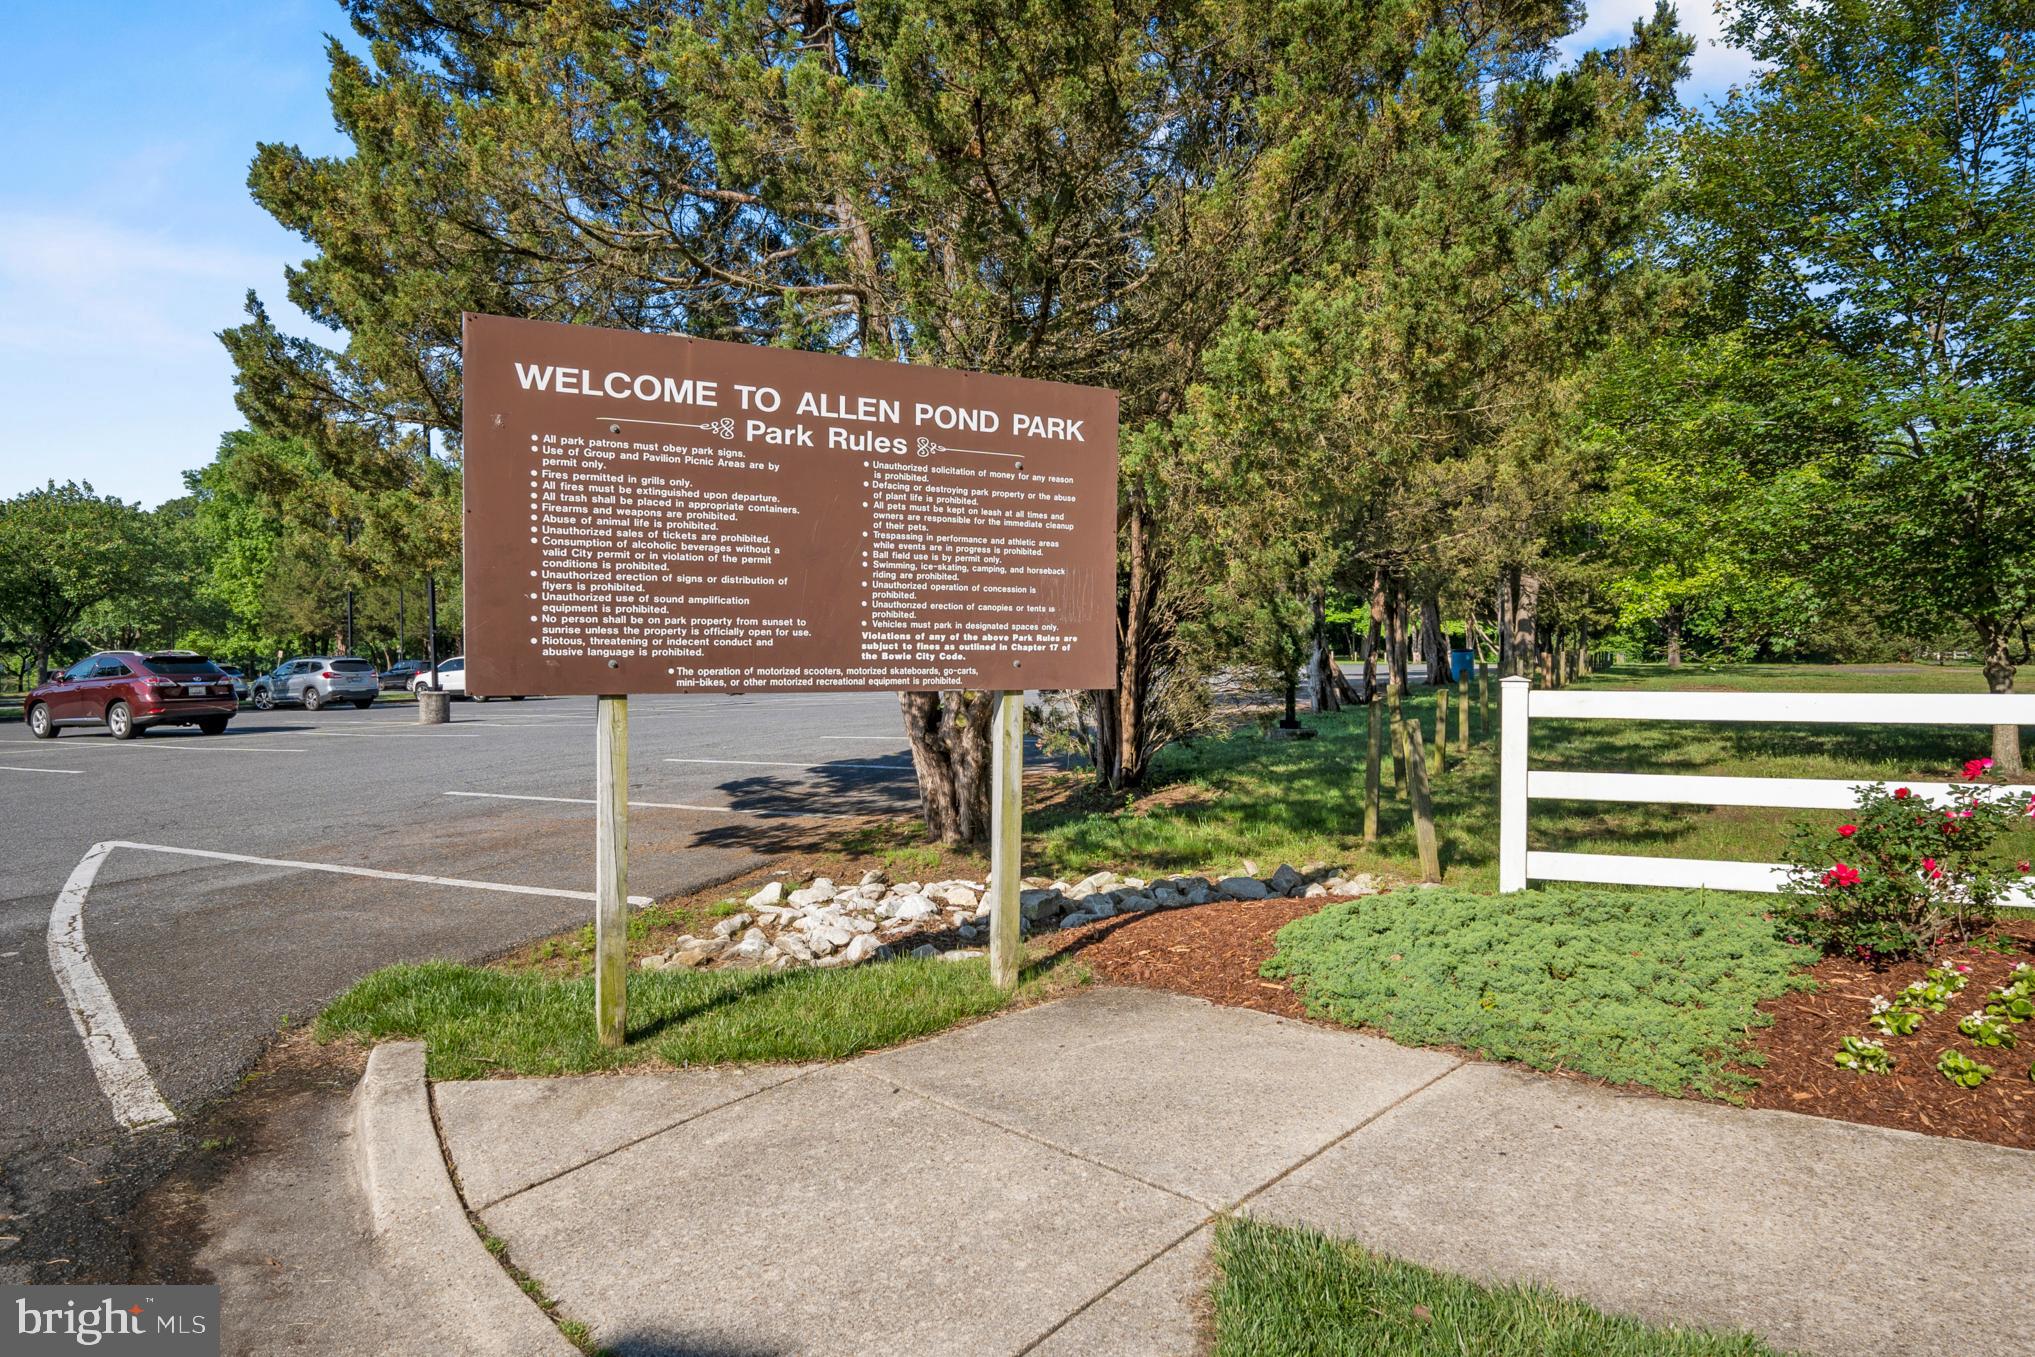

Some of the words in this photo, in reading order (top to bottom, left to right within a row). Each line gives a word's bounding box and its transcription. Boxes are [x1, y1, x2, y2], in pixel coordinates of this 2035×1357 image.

[514, 362, 717, 406] WELCOME
[733, 384, 781, 412] TO
[796, 391, 899, 423] ALLEN
[915, 402, 999, 432] POND
[1013, 413, 1084, 441] PARK
[746, 419, 814, 447] Park
[828, 426, 907, 454] Rules
[543, 434, 556, 443] All
[560, 436, 584, 445] park
[588, 439, 629, 449] patrons
[633, 442, 658, 451] must
[662, 443, 687, 454] obey
[691, 446, 713, 455] park
[717, 447, 745, 458] signs.
[542, 444, 563, 455] Use
[568, 447, 579, 456] of
[583, 447, 615, 460] Group
[619, 451, 639, 460] and
[642, 452, 680, 463] Pavilion
[684, 455, 713, 466] Picnic
[717, 458, 745, 468] Areas
[768, 461, 779, 472] by
[542, 458, 576, 466] permit
[581, 459, 606, 470] only.
[541, 469, 568, 479] Fires
[572, 473, 623, 482] permitted
[627, 474, 636, 483] in
[640, 476, 665, 486] grills
[669, 478, 692, 488] only.
[872, 460, 928, 472] Unauthorized
[931, 466, 975, 476] solicitation
[977, 469, 986, 477] of
[989, 471, 1015, 480] money
[1018, 472, 1029, 480] for
[1031, 474, 1045, 483] any
[873, 470, 881, 478] is
[884, 472, 929, 482] prohibited.
[542, 480, 555, 489] All
[560, 481, 583, 491] fires
[588, 485, 614, 493] must
[618, 485, 631, 494] be
[636, 486, 699, 497] extinguished
[703, 492, 727, 500] upon
[731, 492, 780, 502] departure.
[872, 480, 909, 491] Defacing
[925, 484, 968, 496] destroying
[971, 488, 988, 496] park
[991, 490, 1024, 499] property
[1038, 492, 1050, 500] the
[1053, 493, 1076, 502] abuse
[873, 491, 882, 499] of
[885, 492, 906, 500] plant
[910, 493, 922, 501] life
[926, 494, 933, 502] is
[936, 496, 978, 505] prohibited.
[542, 491, 555, 500] All
[560, 493, 587, 502] trash
[592, 495, 615, 503] shall
[620, 495, 633, 504] be
[637, 497, 671, 506] placed
[675, 499, 684, 507] in
[688, 501, 744, 511] appropriate
[747, 504, 799, 514] containers.
[542, 502, 588, 513] Firearms
[592, 506, 612, 514] and
[616, 508, 661, 517] weapons
[686, 511, 737, 520] prohibited.
[542, 513, 576, 523] Abuse
[581, 516, 591, 524] of
[596, 517, 629, 526] animal
[634, 518, 649, 527] life
[654, 519, 662, 527] is
[666, 520, 718, 530] prohibited.
[541, 524, 611, 536] Unauthorized
[616, 529, 643, 537] sales
[647, 530, 658, 538] of
[662, 530, 696, 540] tickets
[720, 533, 771, 543] prohibited.
[542, 536, 612, 547] Consumption
[616, 539, 627, 547] of
[631, 540, 676, 550] alcoholic
[681, 542, 731, 553] beverages
[735, 544, 770, 554] without
[872, 550, 888, 558] Ball
[892, 551, 910, 559] field
[942, 553, 951, 562] by
[983, 555, 1001, 564] only.
[871, 590, 916, 599] prohibited.
[872, 580, 927, 589] Unauthorized
[930, 583, 968, 591] operation
[982, 585, 1027, 593] concession
[541, 613, 557, 623] No
[561, 616, 598, 624] person
[602, 615, 626, 623] shall
[630, 615, 643, 624] be
[664, 616, 686, 625] park
[690, 617, 732, 626] property
[736, 617, 758, 625] from
[762, 618, 793, 626] sunset
[796, 618, 806, 626] to
[541, 635, 585, 646] Riotous,
[589, 636, 648, 647] threatening
[666, 637, 709, 645] indecent
[713, 637, 752, 646] conduct
[755, 638, 773, 646] and
[861, 631, 910, 640] Violations
[915, 632, 924, 640] of
[949, 632, 959, 640] of
[981, 633, 1009, 641] above
[1012, 633, 1033, 641] Park
[541, 647, 583, 656] abusive
[587, 647, 634, 657] language
[638, 647, 647, 656] is
[651, 647, 704, 657] prohibited.
[676, 666, 694, 675] The
[697, 666, 740, 677] operation
[743, 666, 753, 675] of
[756, 666, 800, 675] motorized
[803, 667, 843, 676] scooters,
[846, 666, 886, 674] motorized
[890, 666, 940, 675] skateboards,
[943, 667, 978, 676] go-carts,
[676, 677, 726, 687] mini-bikes,
[743, 677, 767, 686] other
[770, 677, 812, 685] motorized
[816, 677, 865, 685] recreational
[868, 677, 910, 686] equipment
[912, 676, 919, 684] is
[922, 676, 962, 686] prohibited.
